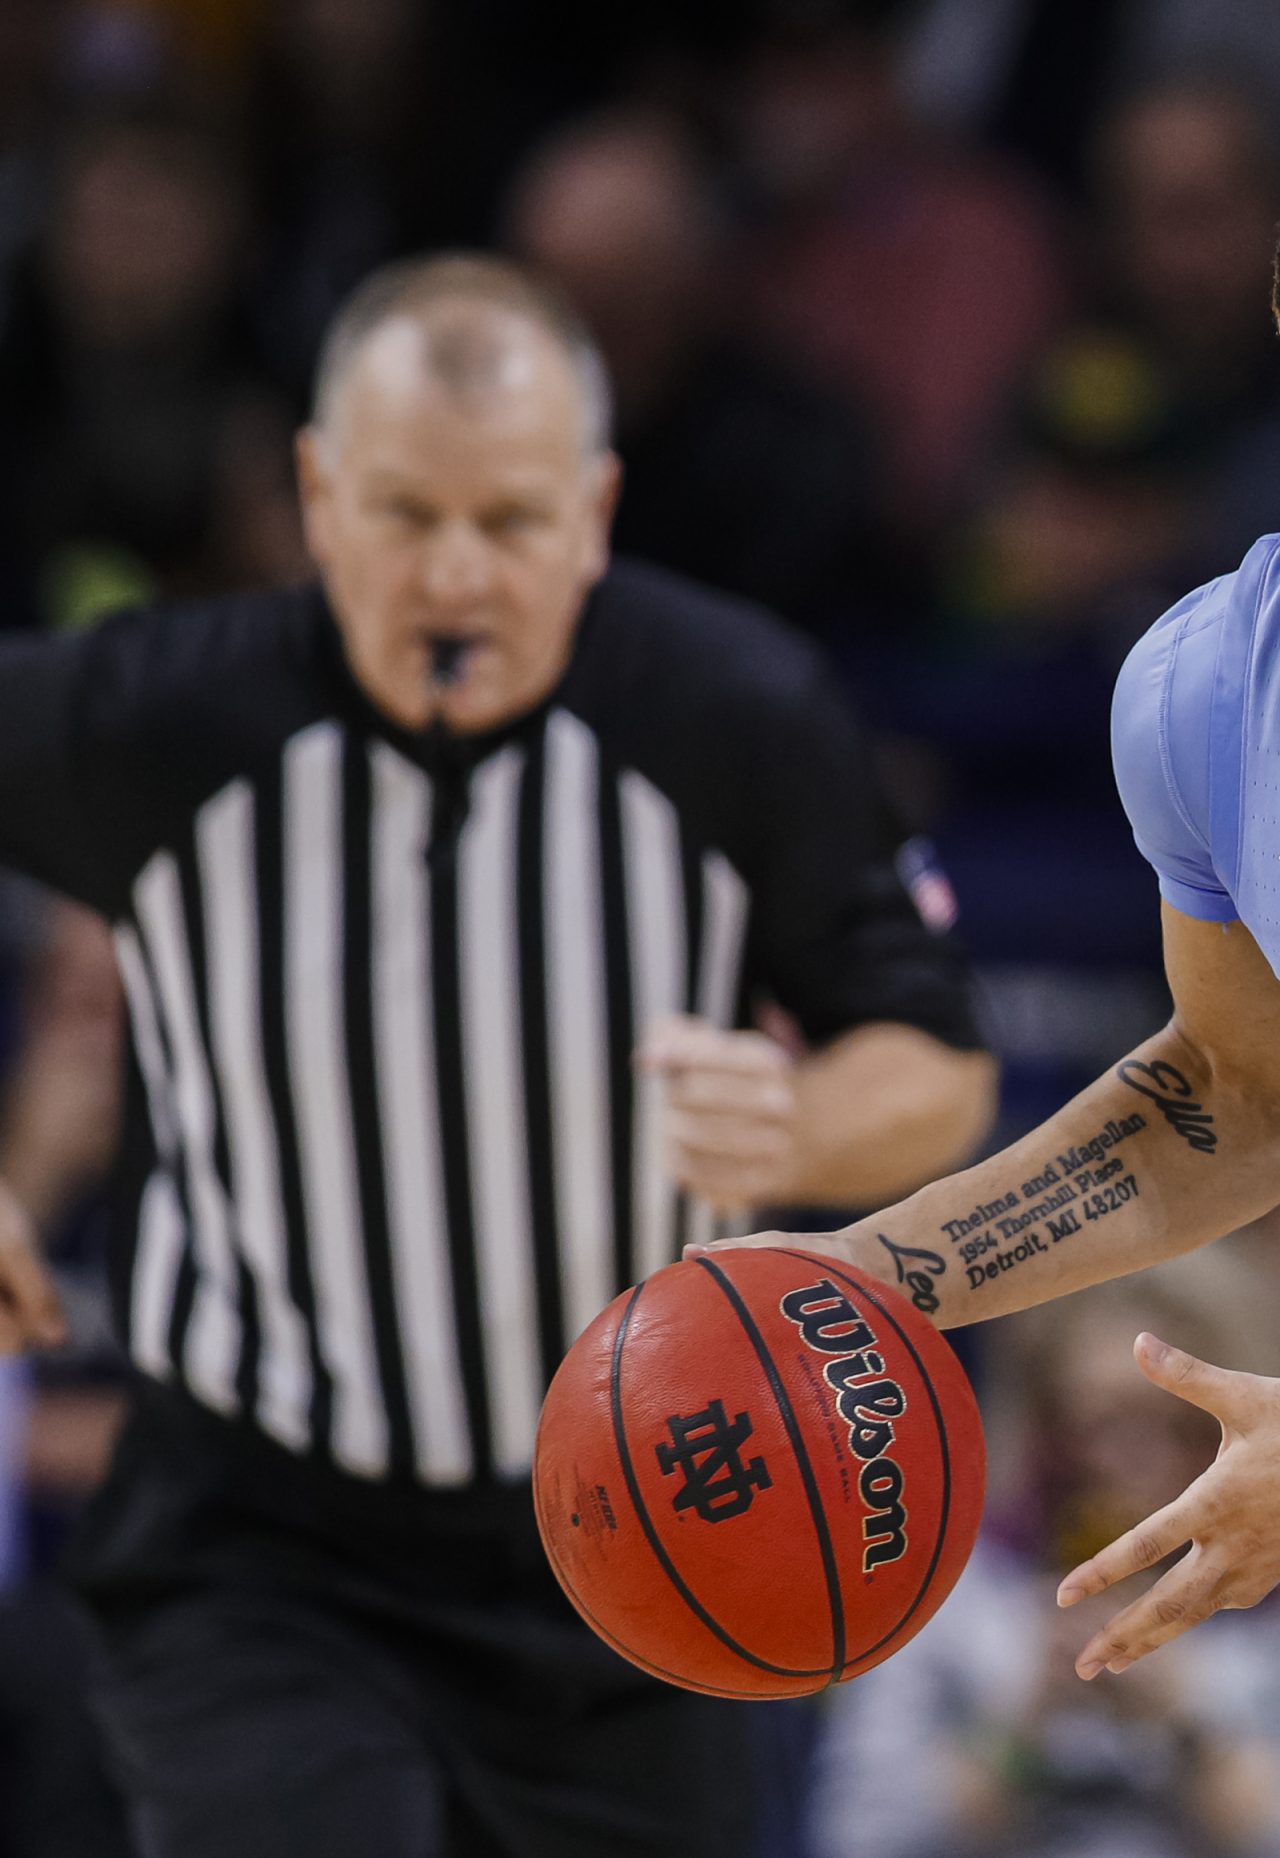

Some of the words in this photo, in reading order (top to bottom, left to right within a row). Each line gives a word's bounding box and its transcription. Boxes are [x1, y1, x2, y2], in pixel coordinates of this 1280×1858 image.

[1116, 1059, 1218, 1154] Ella
[941, 1192, 1020, 1242] Thelma
[1021, 1163, 1061, 1199] and
[1056, 1113, 1147, 1176] Magellan
[959, 1230, 998, 1265] 1954
[995, 1184, 1078, 1240] Thornhill
[1074, 1157, 1124, 1194] Place
[965, 1233, 1048, 1290] Detroit,
[1045, 1208, 1082, 1243] MI
[1082, 1174, 1140, 1221] 48207
[878, 1233, 947, 1313] Leo
[780, 1278, 910, 1574] Wilson
